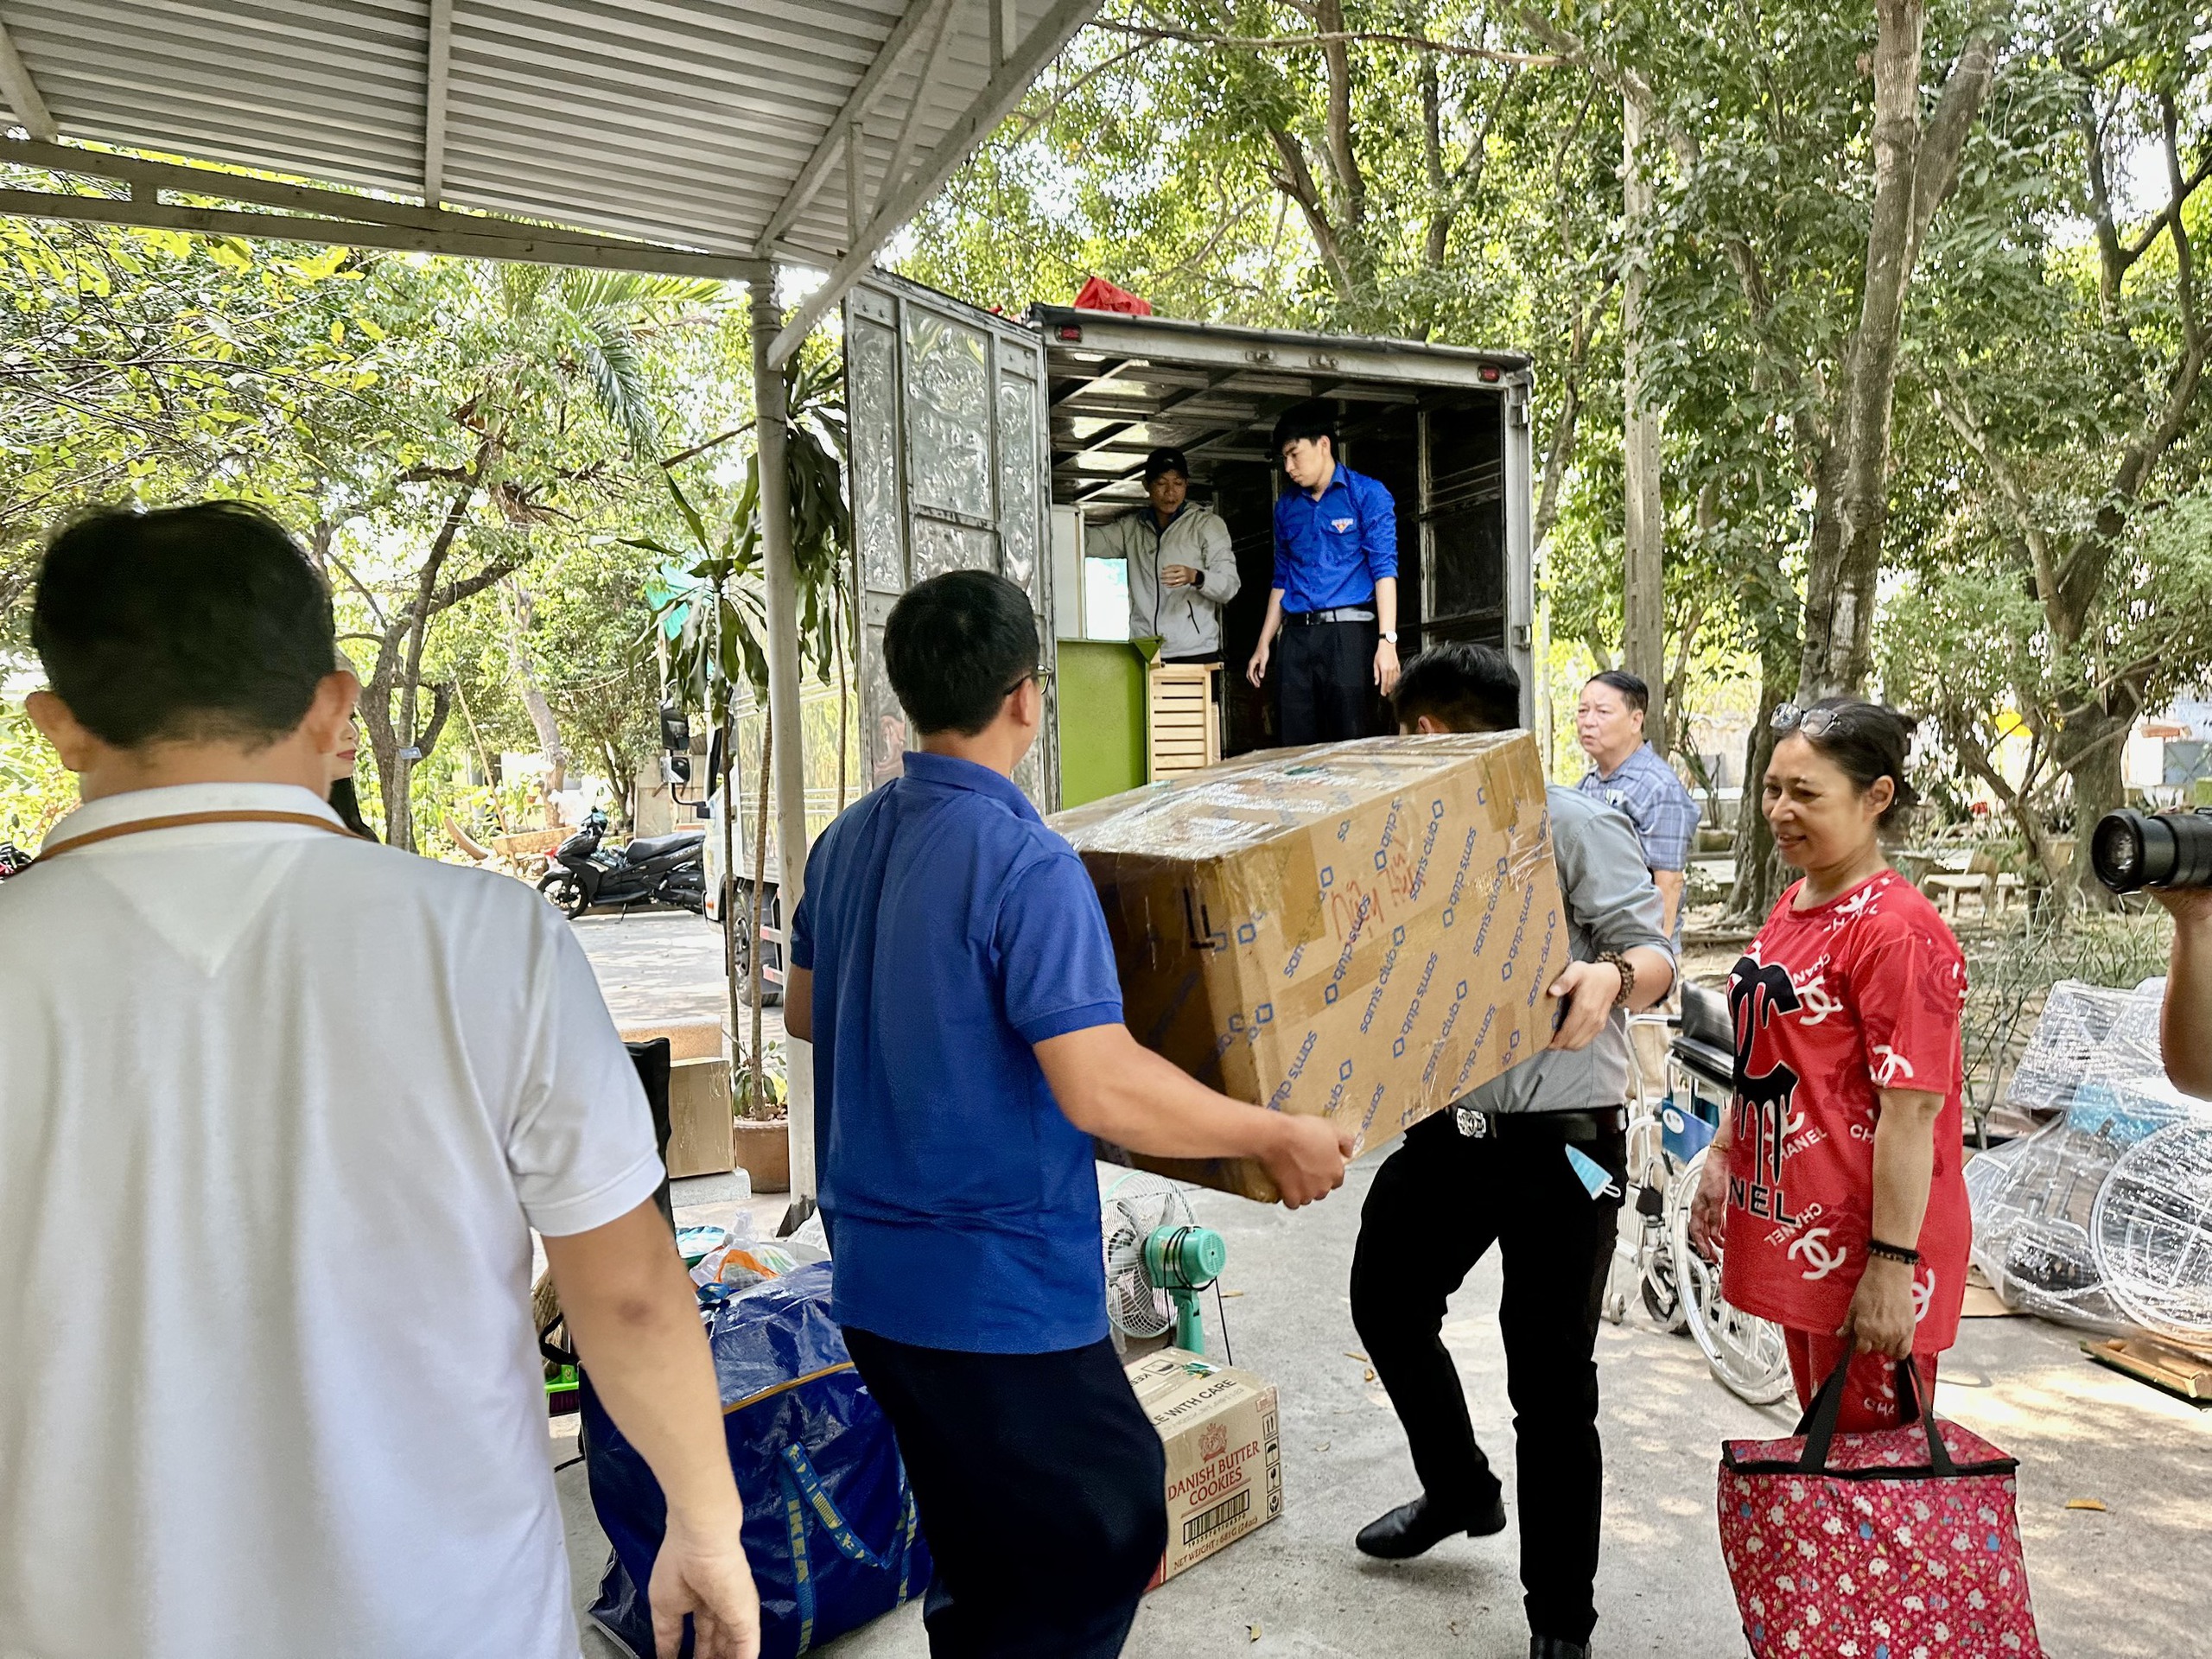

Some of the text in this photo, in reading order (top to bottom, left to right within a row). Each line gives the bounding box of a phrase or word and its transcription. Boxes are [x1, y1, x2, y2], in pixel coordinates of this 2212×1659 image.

[1409, 820, 1440, 902] sam's club
[1449, 825, 1477, 906] sam's club
[1472, 912, 1492, 957] sam's
[1509, 925, 1523, 960] club
[1541, 931, 1554, 965] club
[1332, 941, 1353, 982] club
[1359, 949, 1397, 1035] sam's club
[1401, 950, 1439, 1035] sam's club
[1441, 1001, 1461, 1038] club
[1459, 1002, 1497, 1084] sam's club
[1287, 1029, 1319, 1080] sam's
[1163, 1397, 1203, 1417] WITH
[1198, 1378, 1237, 1399] CARE
[1167, 1440, 1261, 1502] DANISH BUTTER
[1189, 1466, 1243, 1506] COOKIES
[787, 1498, 810, 1586] IKEA
[1173, 1554, 1188, 1570] NET
[1188, 1538, 1216, 1561] WEIGHT
